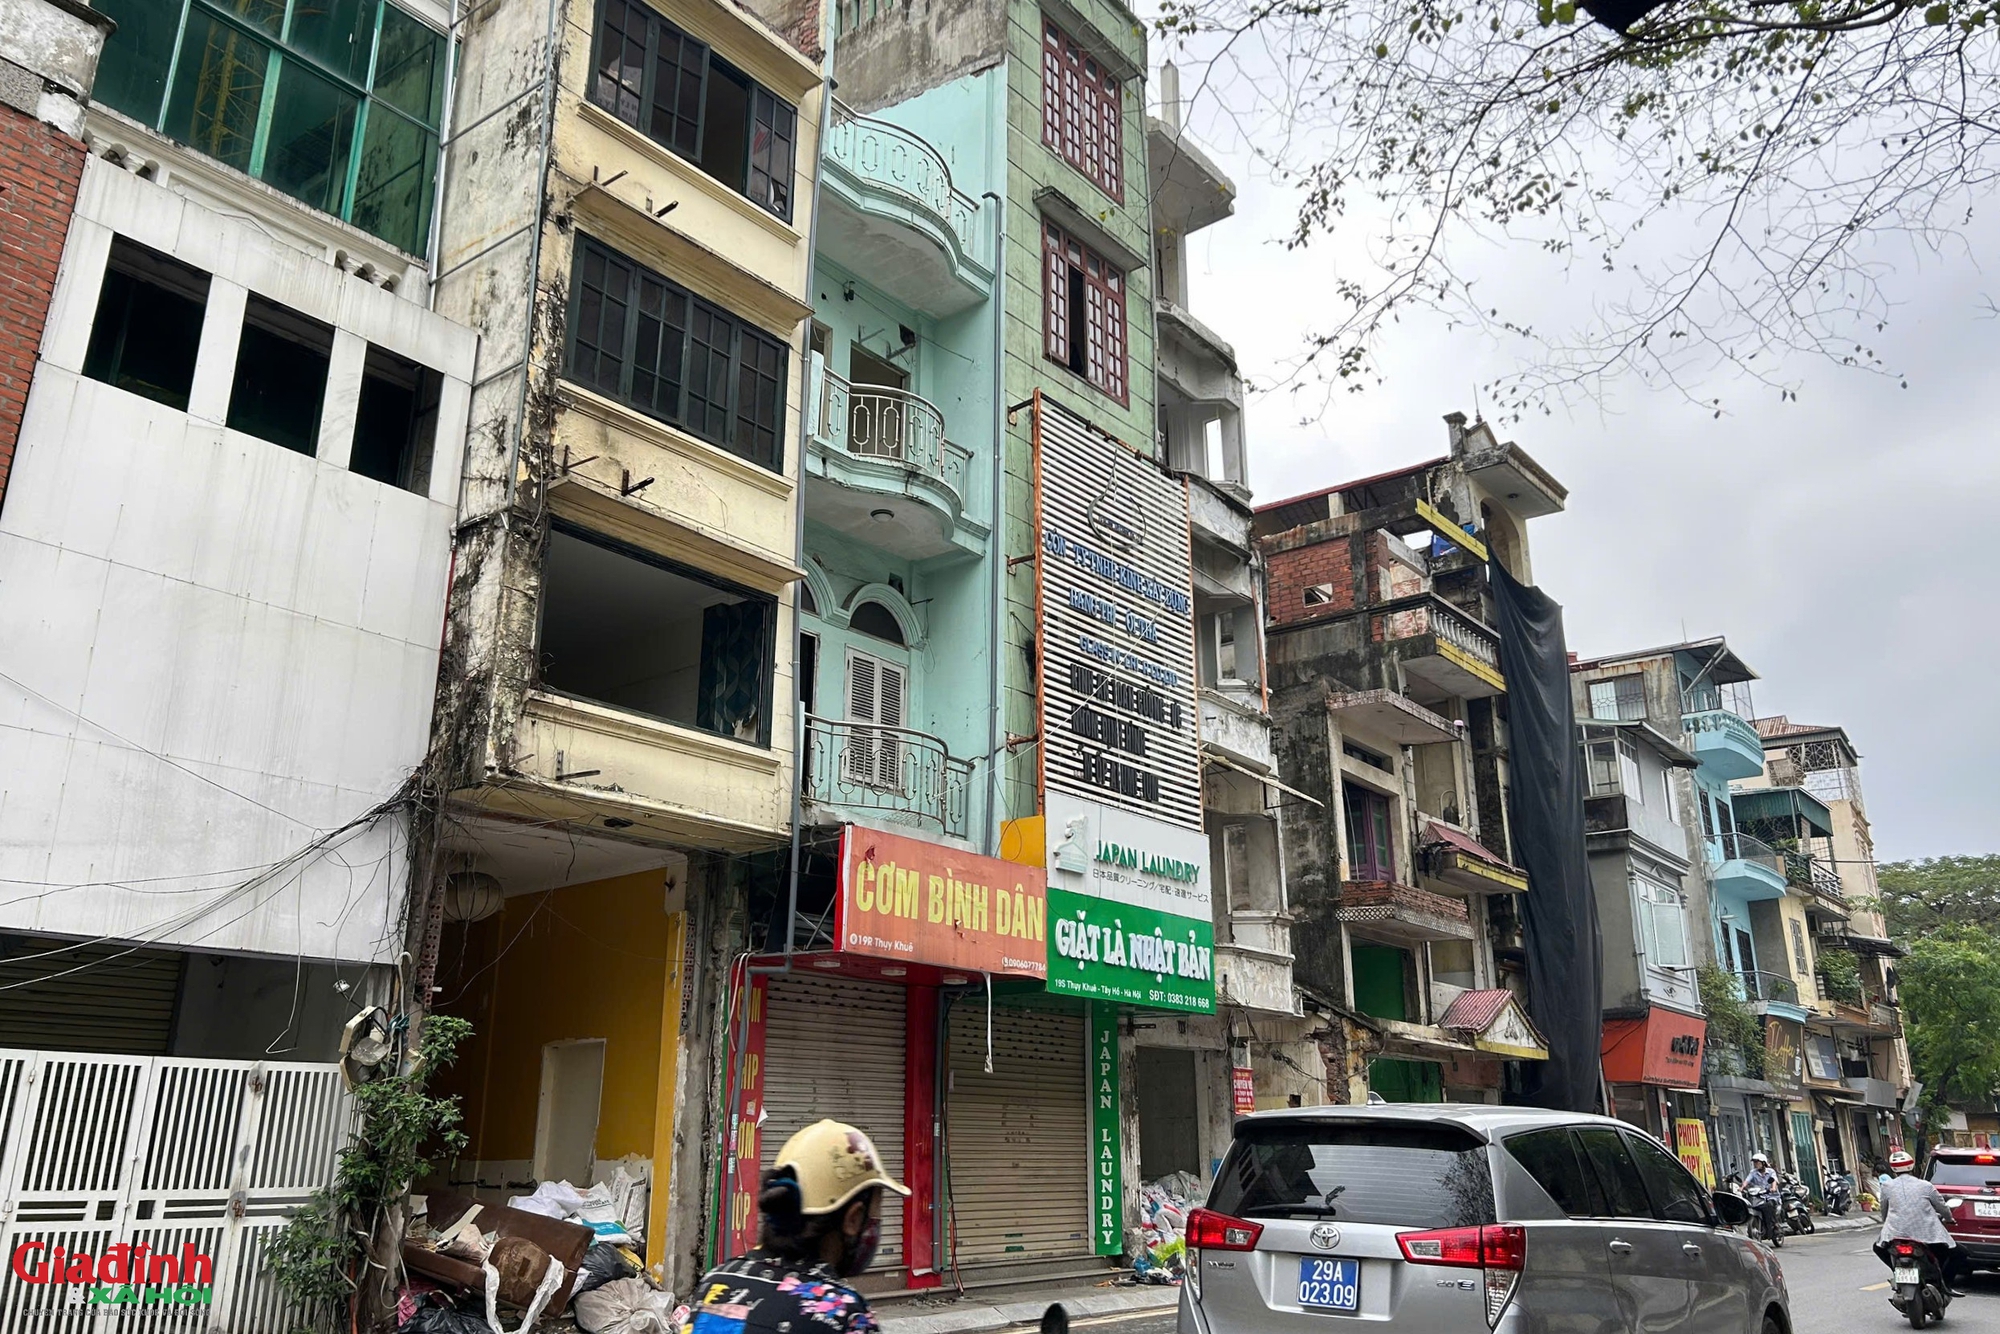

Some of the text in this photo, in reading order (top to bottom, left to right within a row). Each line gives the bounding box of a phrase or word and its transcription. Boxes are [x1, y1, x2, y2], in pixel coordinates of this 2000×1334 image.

[1095, 839, 1200, 885] JAPAN LAUNDRY
[856, 860, 1044, 942] CƠM BÌNH DÂN
[874, 937, 893, 951] Thụy
[1055, 909, 1210, 983] GIẶT LÀ NHẬT BẢN
[1149, 989, 1166, 1002] SĐT:
[1167, 992, 1183, 1005] 0383
[1184, 995, 1196, 1007] 218
[1197, 997, 1210, 1009] 668
[734, 1053, 759, 1090] HIP
[1100, 1030, 1114, 1245] JAPAN LAUNDRY
[1677, 1123, 1700, 1147] PHOTO
[1312, 1259, 1343, 1282] 29A
[1299, 1281, 1355, 1306] 023.09
